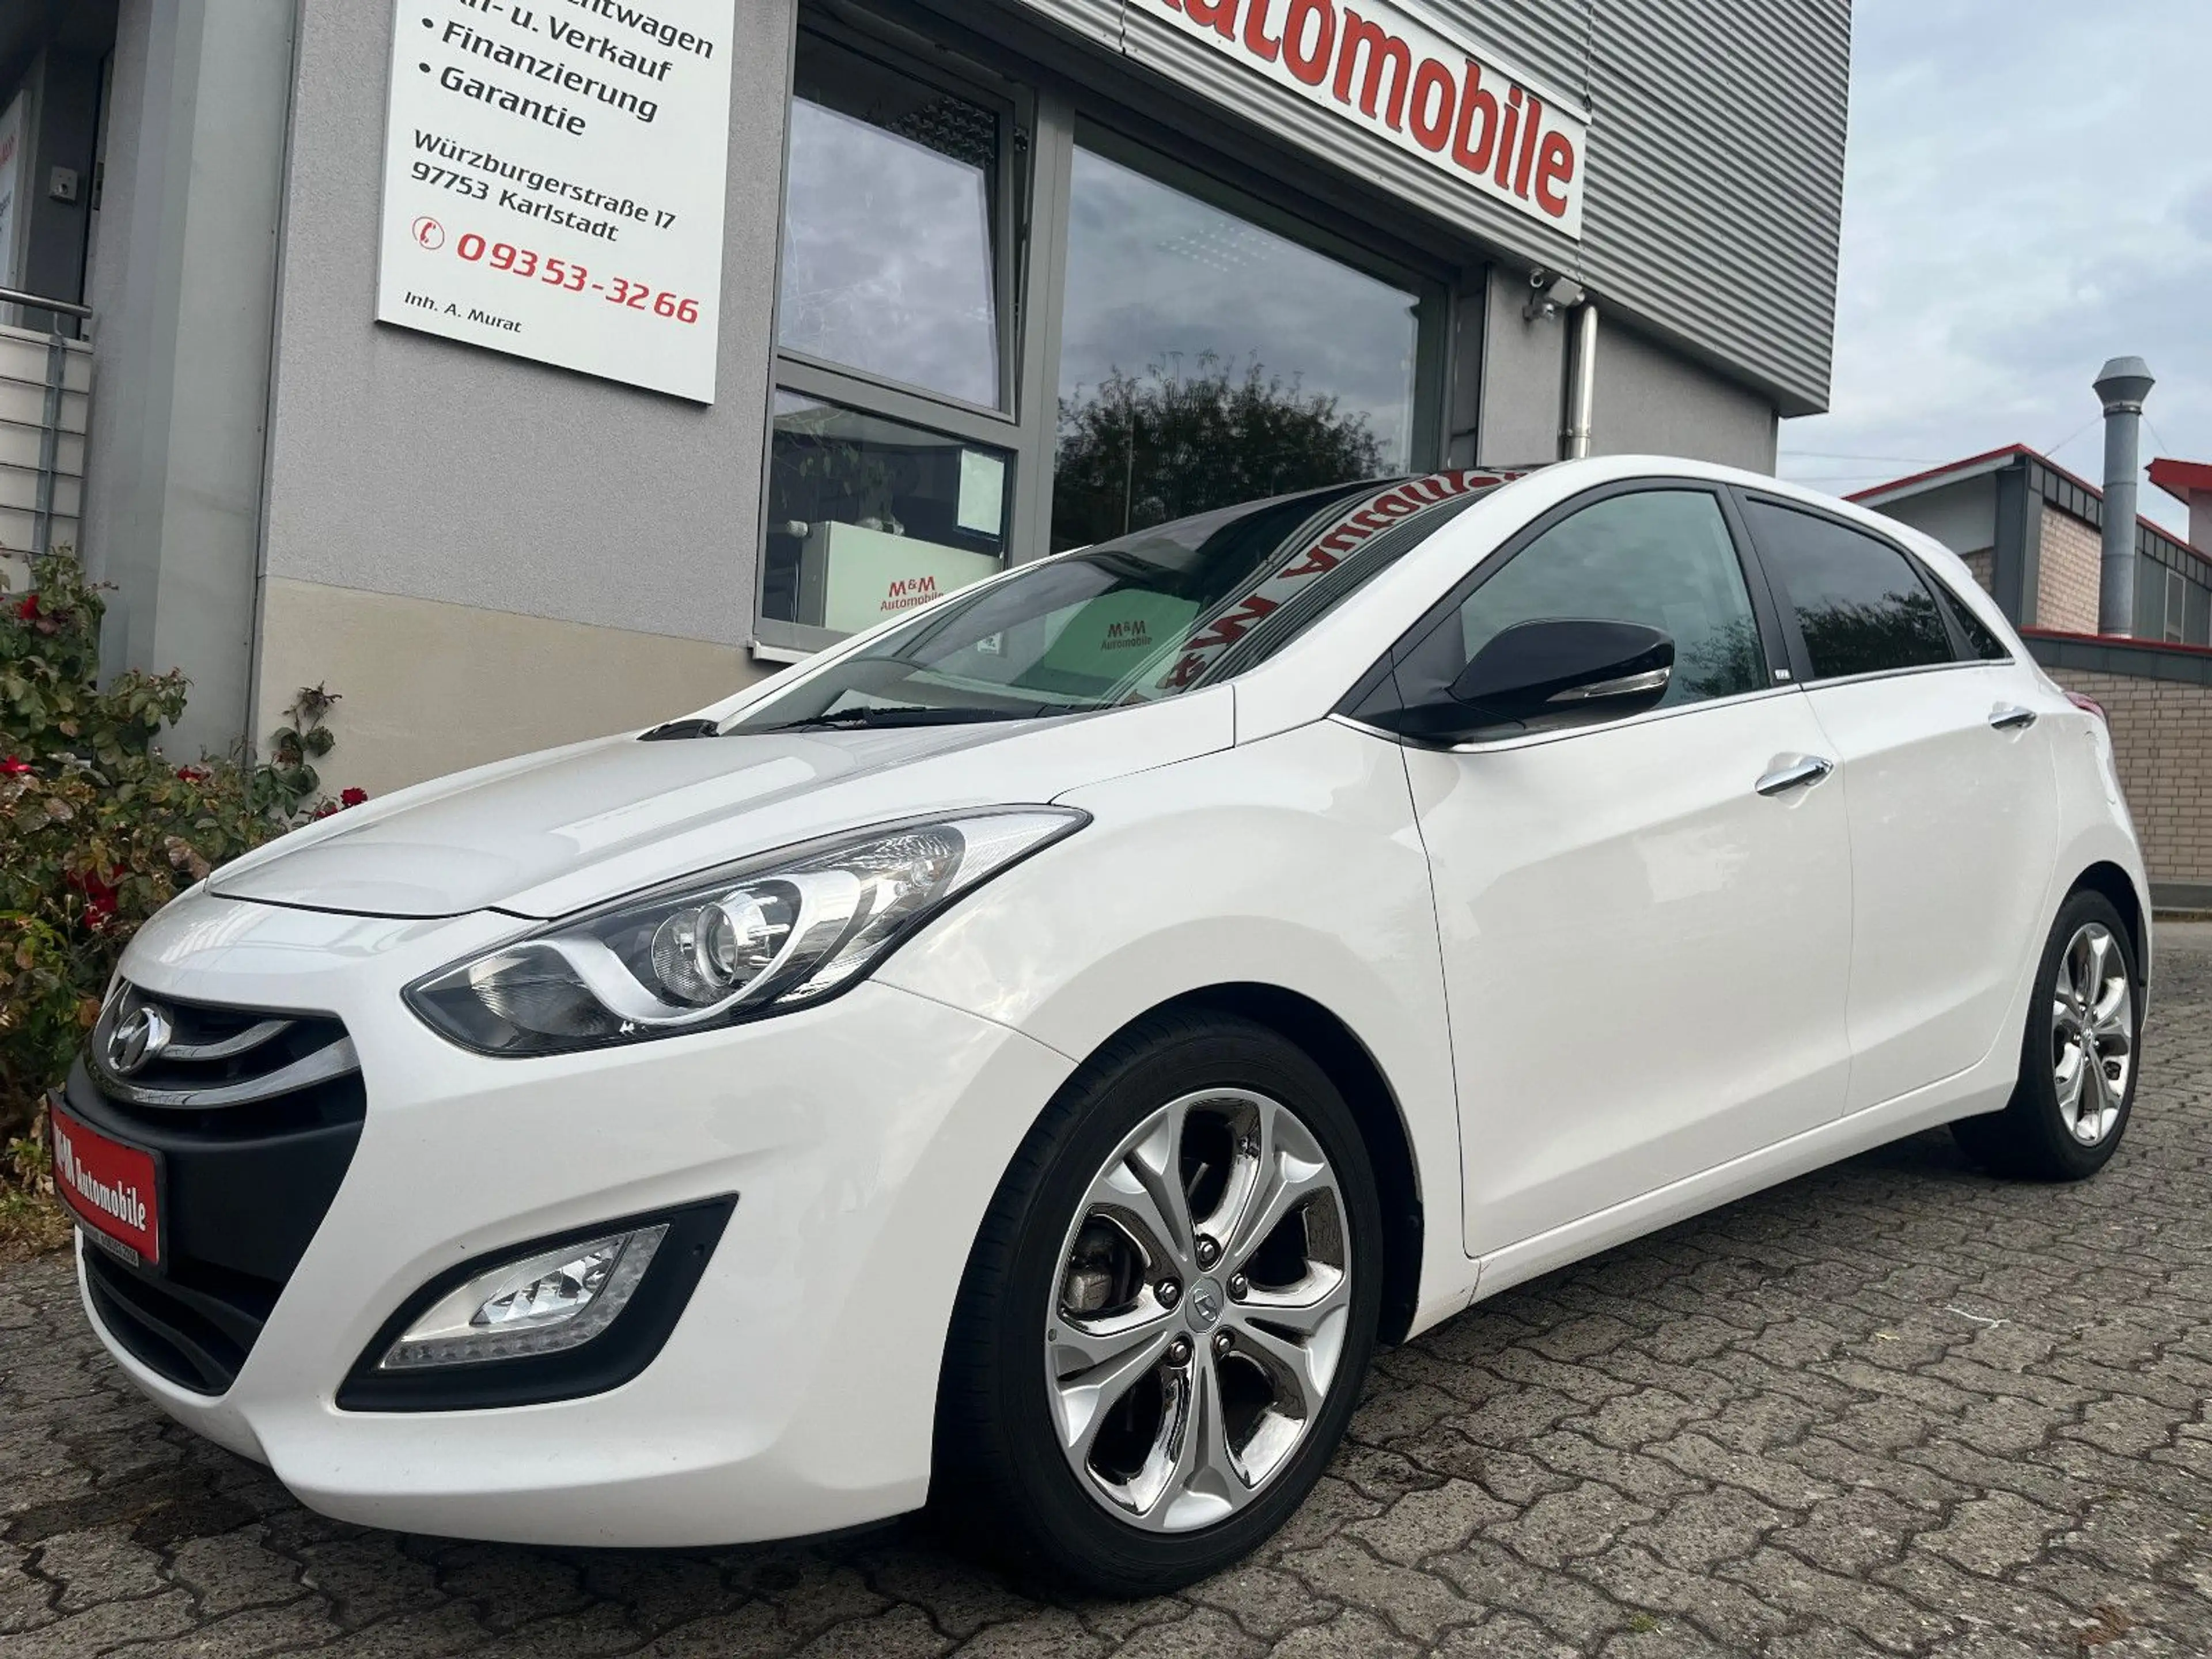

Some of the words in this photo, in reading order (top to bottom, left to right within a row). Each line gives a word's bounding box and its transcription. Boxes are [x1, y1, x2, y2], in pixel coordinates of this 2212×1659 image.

[442, 21, 658, 123] Finanzierung
[510, 6, 539, 32] u.
[550, 16, 673, 82] Verkauf
[441, 66, 586, 135] Garantie
[411, 162, 488, 200] 97753
[499, 189, 619, 241] Karlstadt
[414, 130, 649, 222] Würzburgerstraße
[655, 210, 676, 230] 17
[404, 291, 437, 311] Inh.
[444, 303, 461, 317] A.
[467, 309, 522, 333] Murat
[889, 576, 935, 597] M&M
[1107, 620, 1146, 638] M&M
[75, 1157, 146, 1231] Automobile
